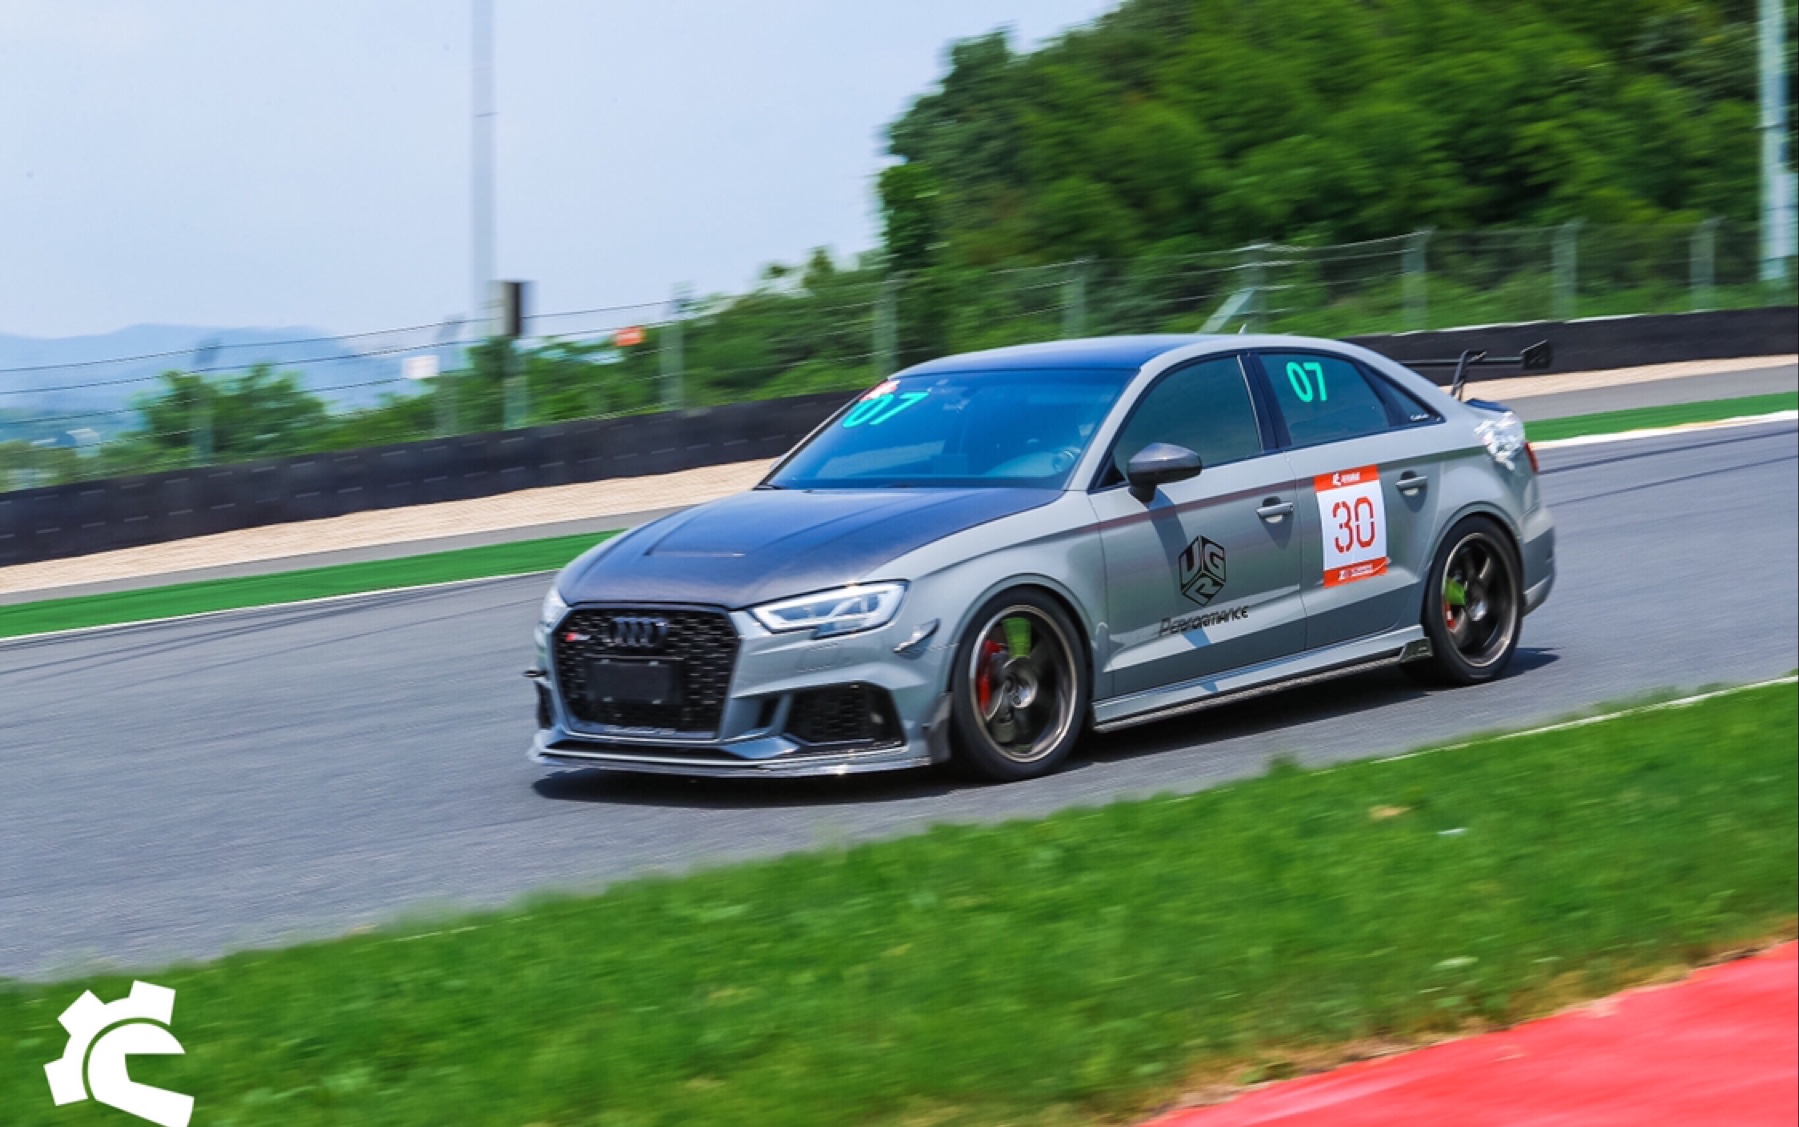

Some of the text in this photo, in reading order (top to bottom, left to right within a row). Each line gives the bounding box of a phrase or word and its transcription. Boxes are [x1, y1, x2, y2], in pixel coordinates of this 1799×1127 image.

[1285, 361, 1327, 402] 07
[843, 392, 929, 427] 07
[1332, 496, 1375, 553] 30
